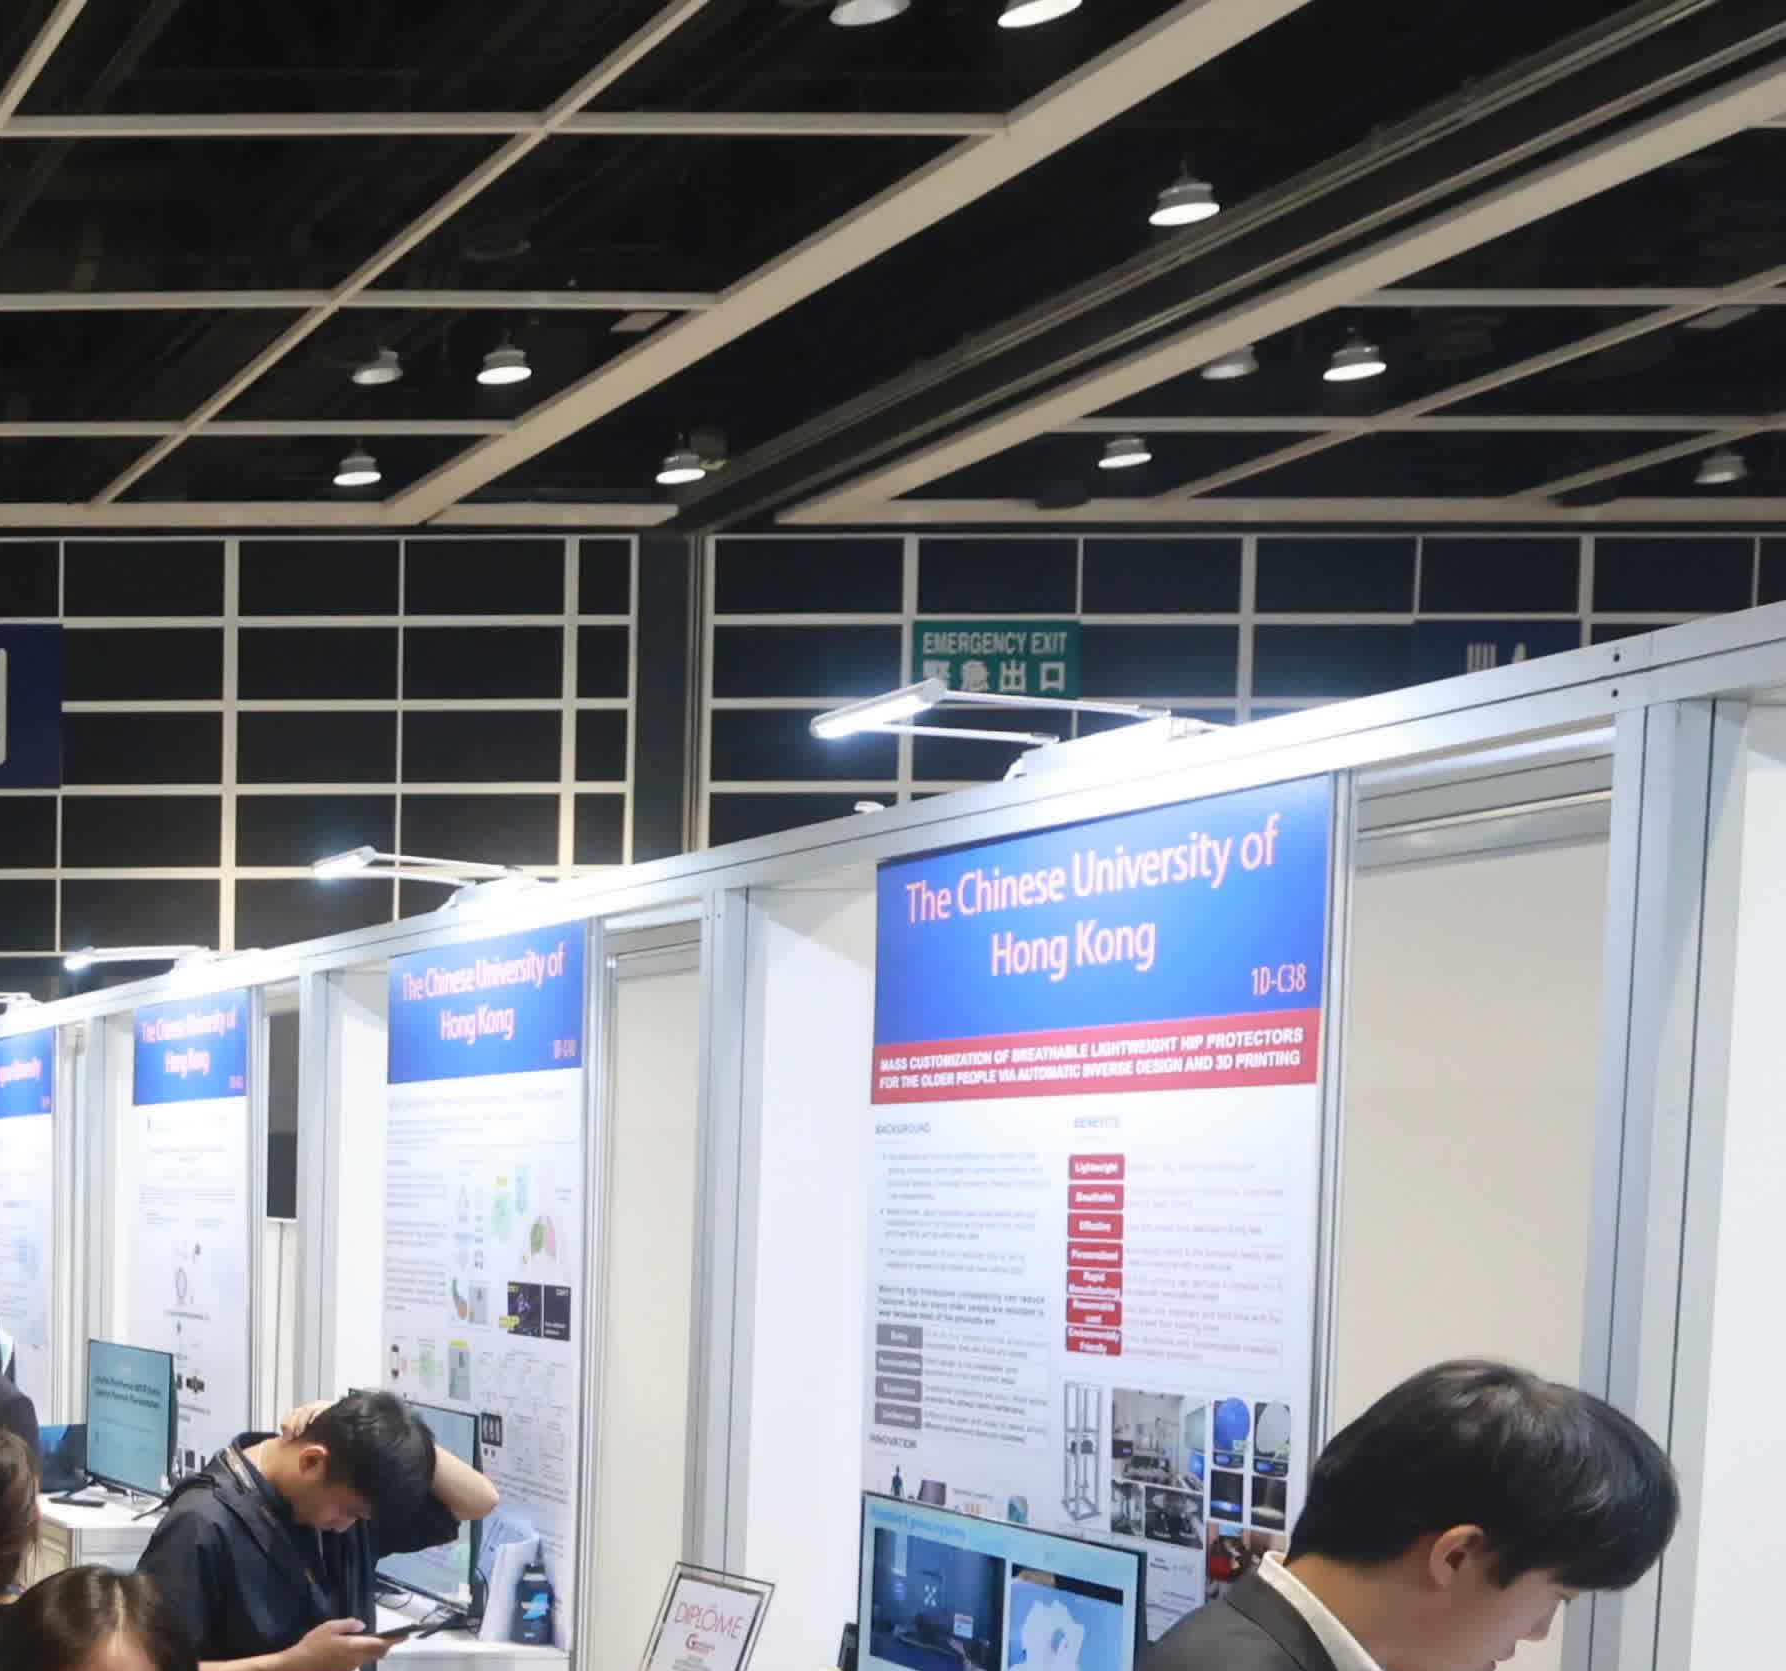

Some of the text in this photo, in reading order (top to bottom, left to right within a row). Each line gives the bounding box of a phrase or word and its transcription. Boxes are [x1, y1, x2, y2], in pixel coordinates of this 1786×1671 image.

[922, 631, 1068, 655] EMERGENCY EXIT
[906, 812, 1281, 925] The Chinese University of
[403, 942, 567, 1001] The Chinese University of
[992, 920, 1157, 982] Hong Kong
[1251, 963, 1307, 996] 1D-C38
[440, 1003, 516, 1046] Hong Kong
[879, 1075, 900, 1089] FOR
[901, 1075, 920, 1089] THE
[921, 1072, 955, 1088] OLDER
[956, 1069, 997, 1085] PEOPLE
[1018, 1063, 1081, 1081] AUTOMATIC
[1082, 1060, 1134, 1079] INVERSE
[1135, 1057, 1183, 1076] DESIGN
[1184, 1056, 1213, 1072] AND
[1215, 1054, 1234, 1071] 3D
[1235, 1049, 1301, 1069] PRINTING
[880, 1027, 1304, 1072] MASS CUSTOMIZATION OF BREATHABLE LIGHTWEIGHT HIP PROTECTORS
